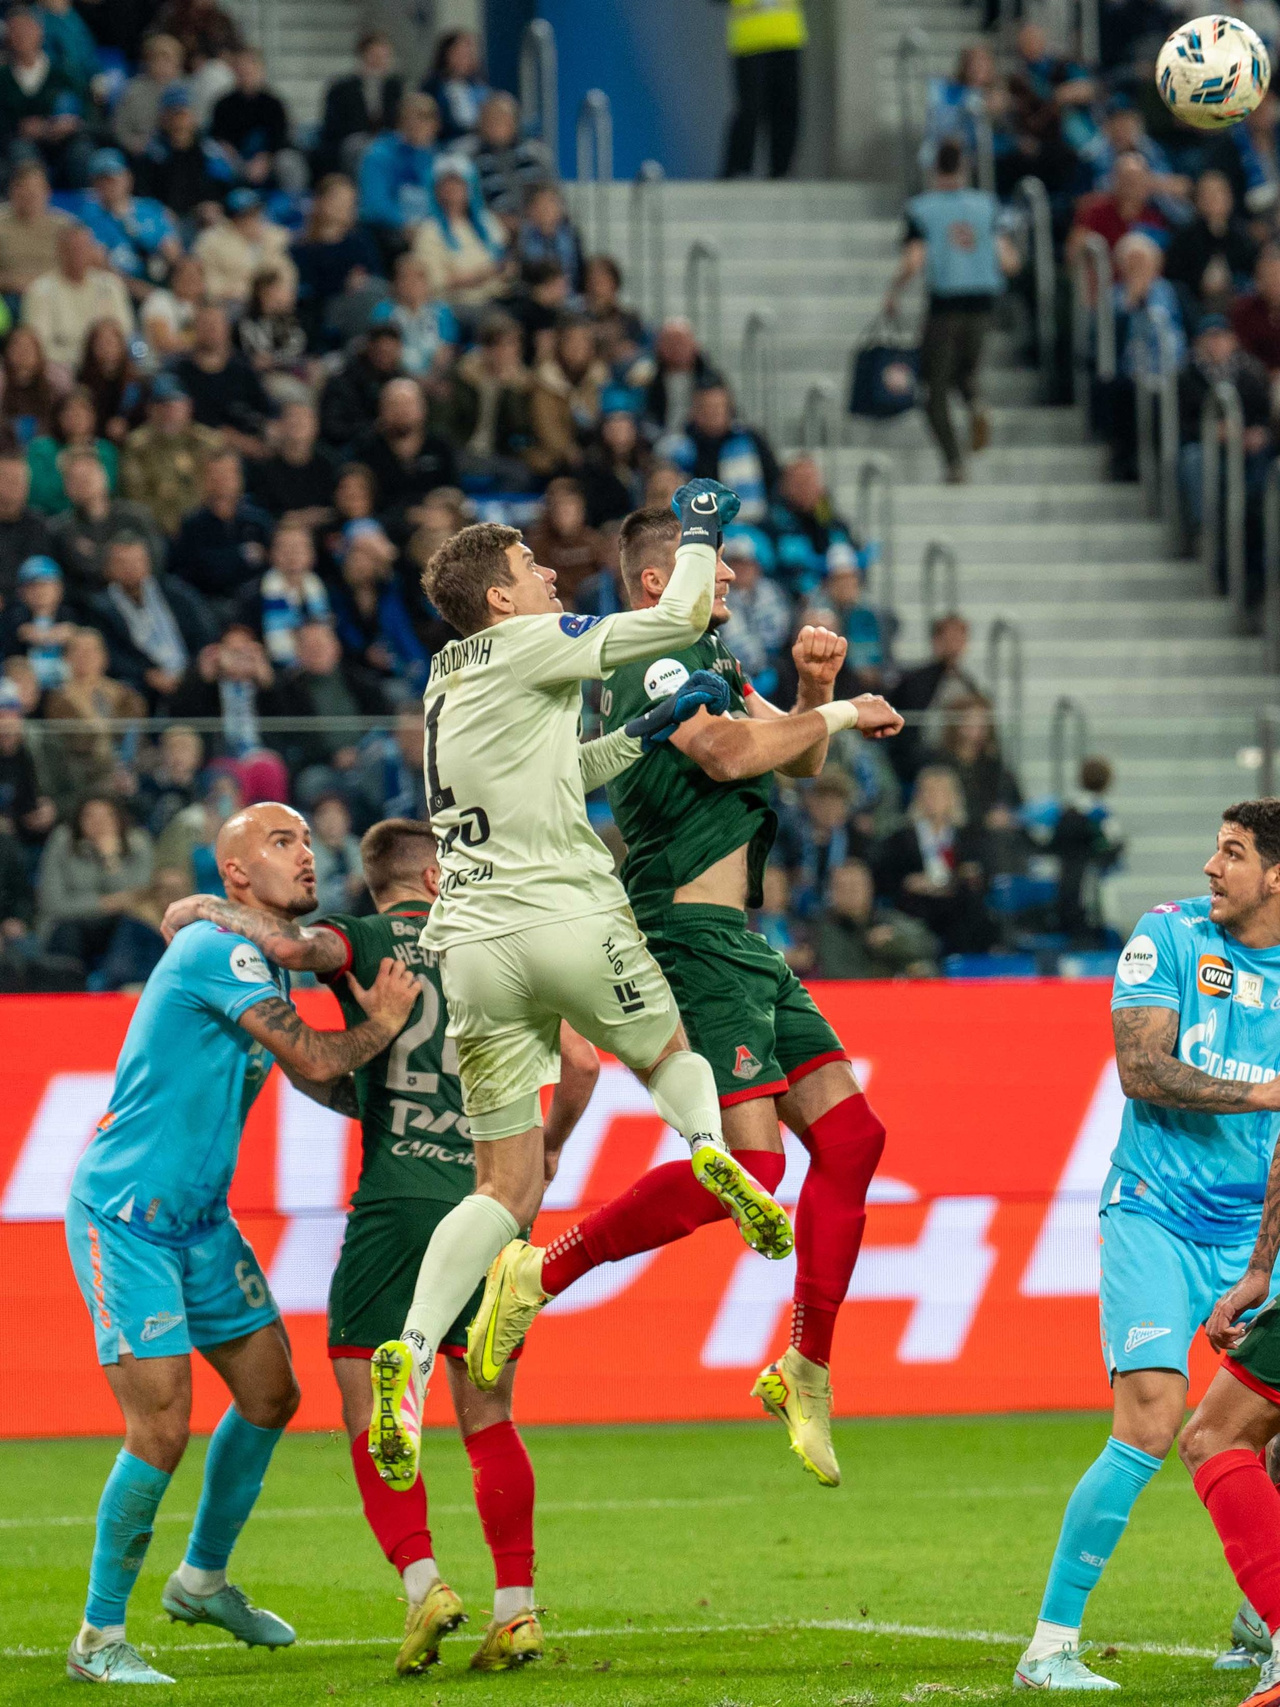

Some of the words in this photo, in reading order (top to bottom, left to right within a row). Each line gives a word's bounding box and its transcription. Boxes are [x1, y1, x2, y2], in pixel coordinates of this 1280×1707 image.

[426, 692, 456, 817] 1
[1205, 968, 1232, 987] WIN
[386, 973, 458, 1094] 2
[234, 1260, 266, 1309] 6
